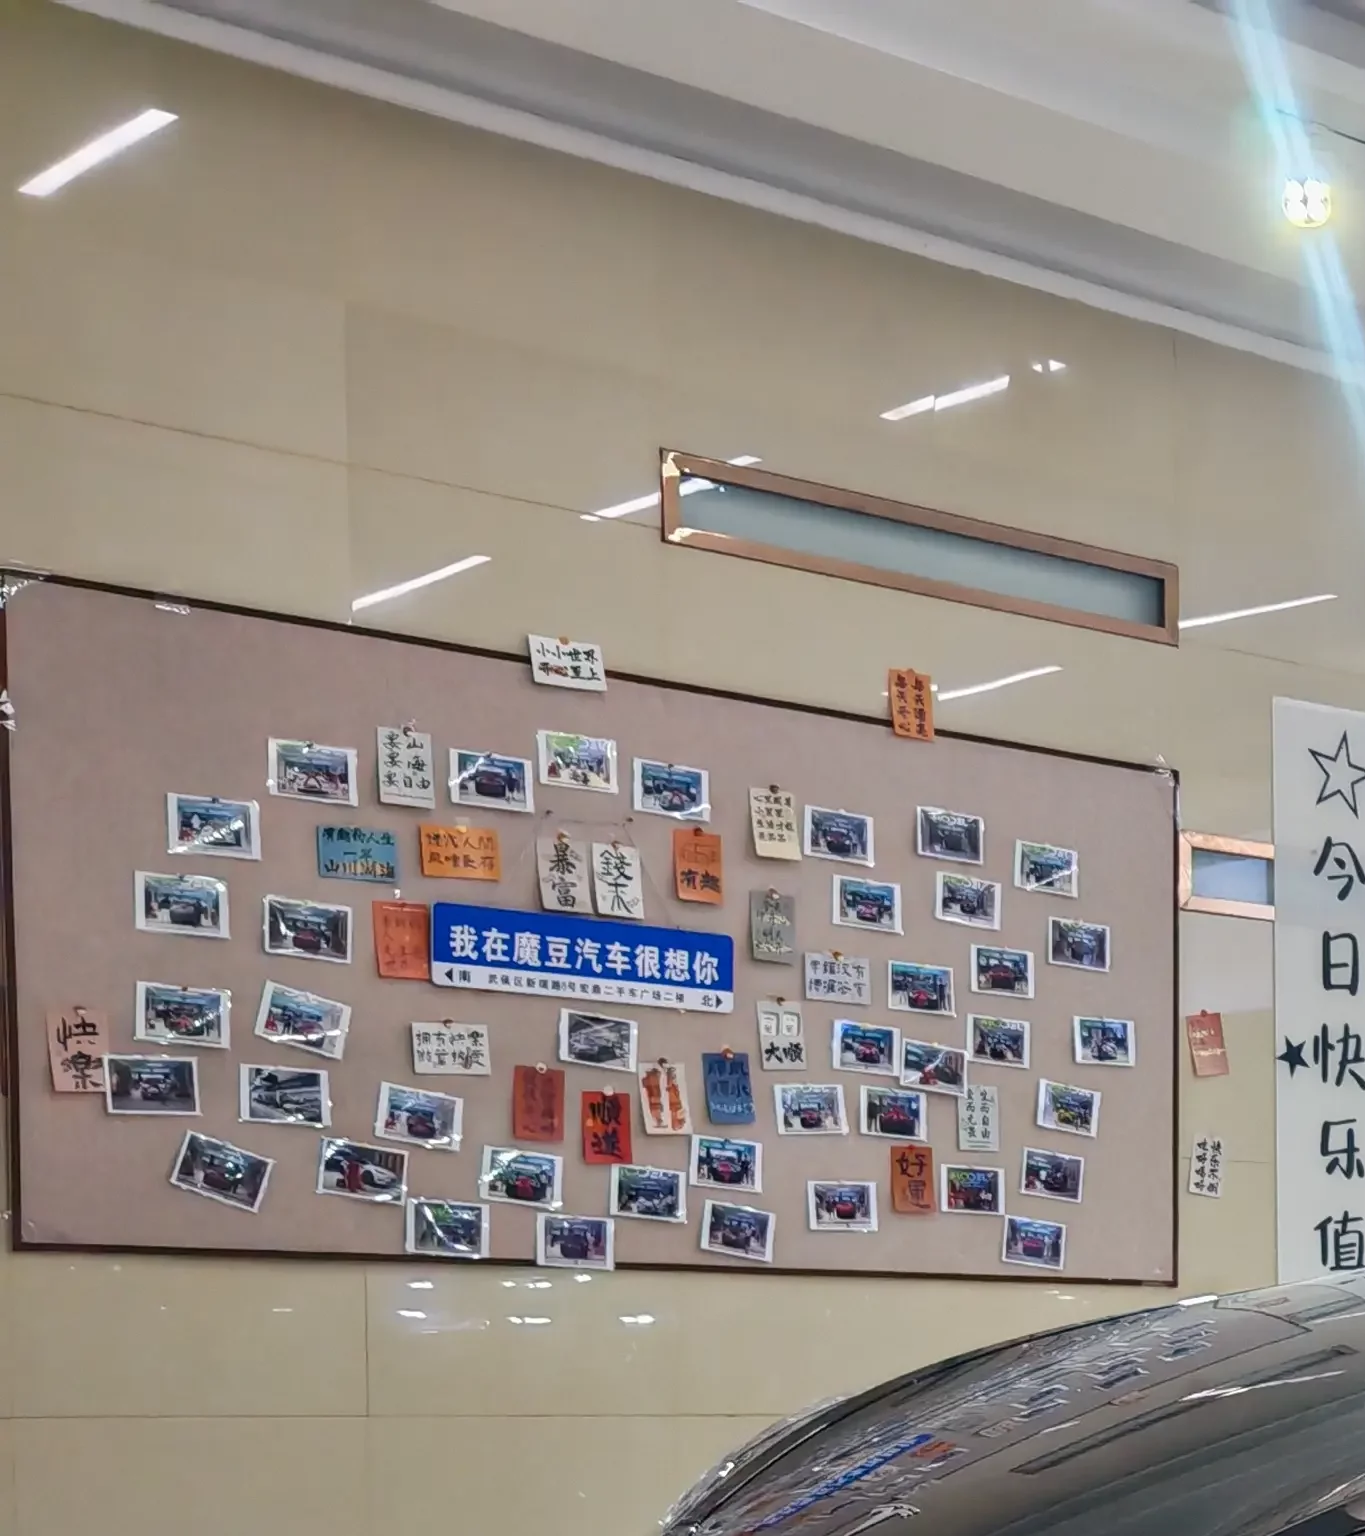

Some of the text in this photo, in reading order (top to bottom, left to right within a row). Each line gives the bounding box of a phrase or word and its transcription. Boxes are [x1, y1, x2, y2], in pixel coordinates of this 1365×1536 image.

[448, 923, 720, 986] 我在魔豆汽车很想你
[458, 969, 471, 985] 南
[701, 994, 714, 1008] 北
